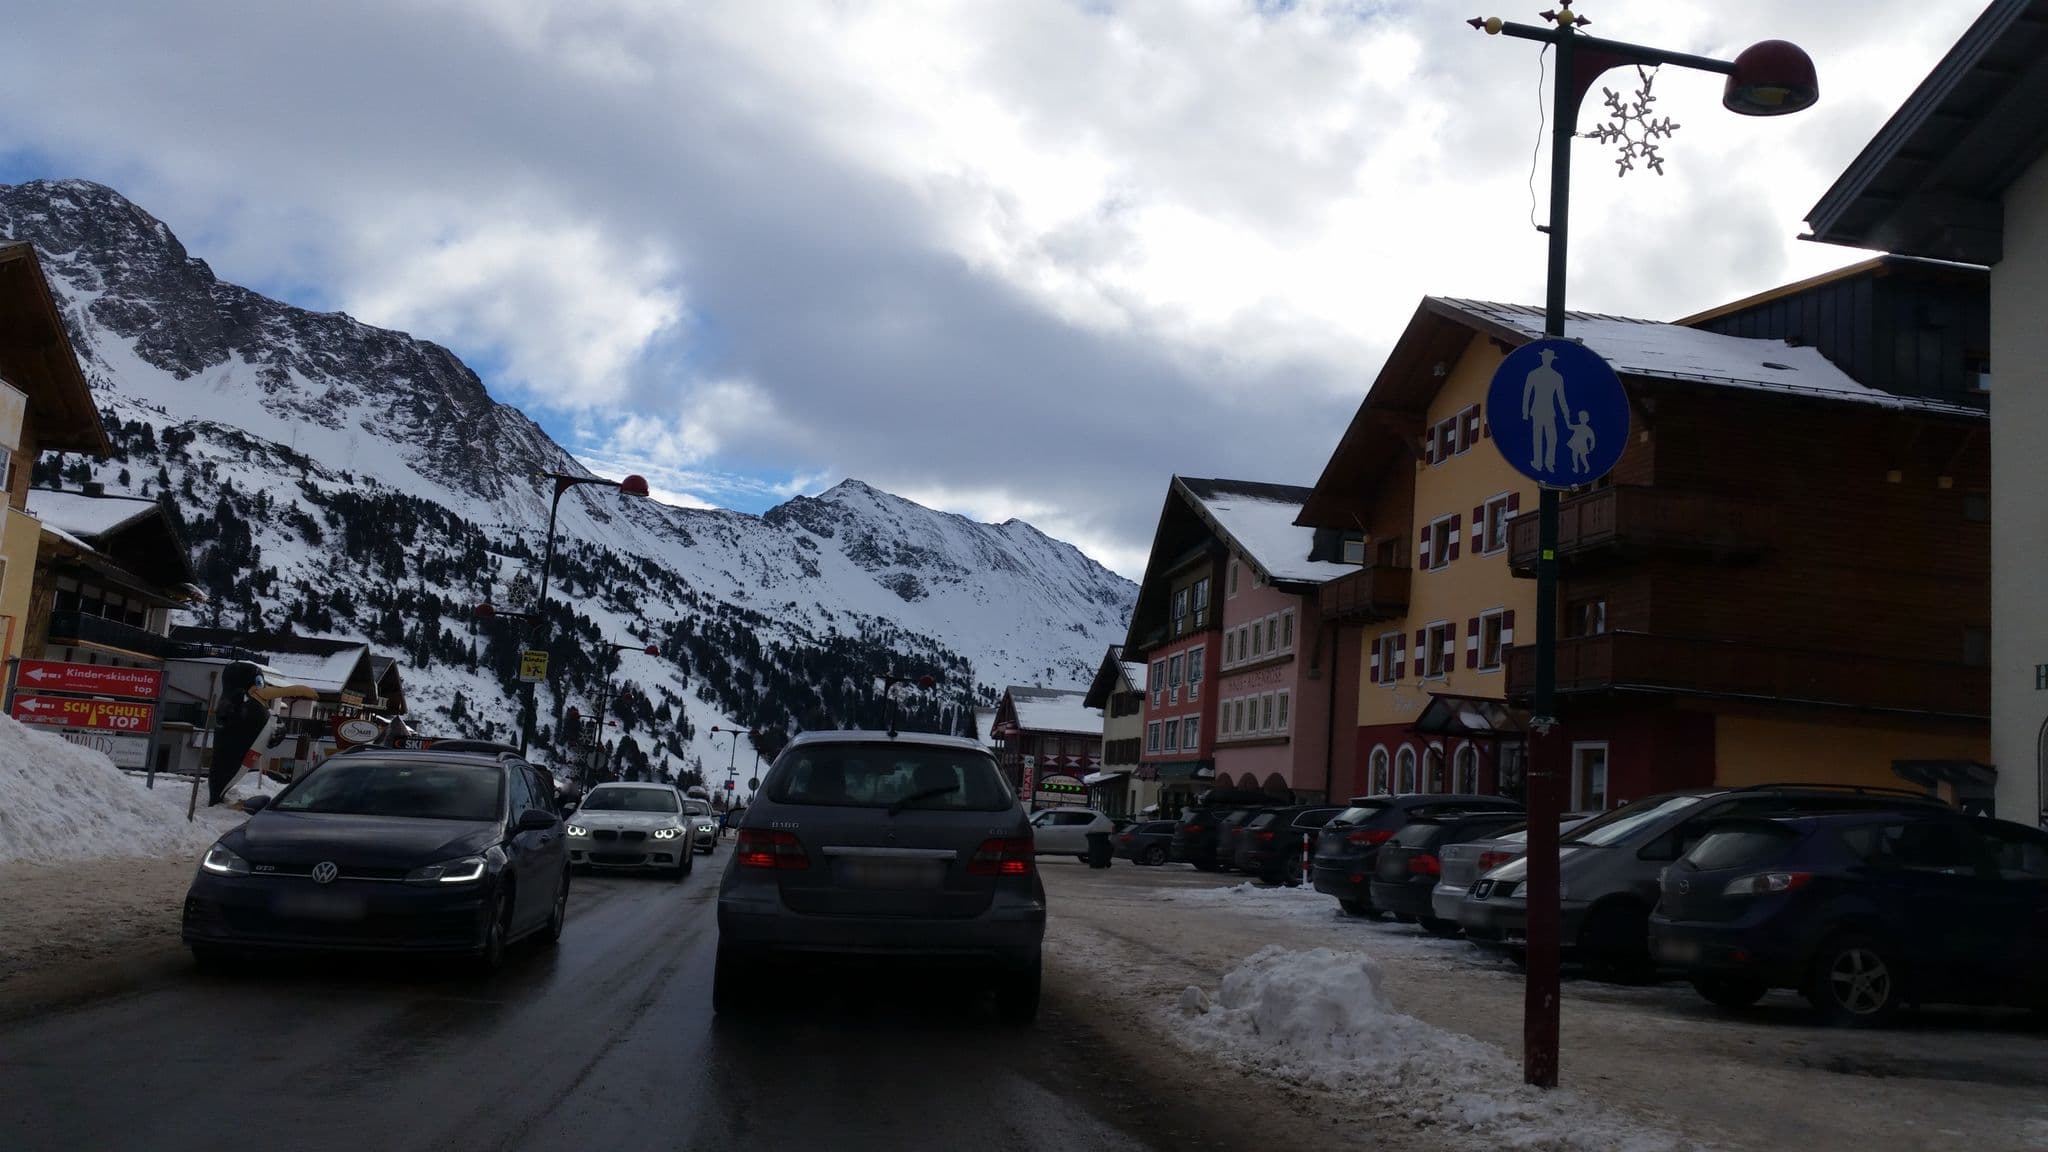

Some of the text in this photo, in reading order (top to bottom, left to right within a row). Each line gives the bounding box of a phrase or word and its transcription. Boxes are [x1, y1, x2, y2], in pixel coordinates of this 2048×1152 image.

[66, 668, 154, 684] Kinder-skischule
[134, 685, 152, 695] top
[108, 716, 139, 728] TOP
